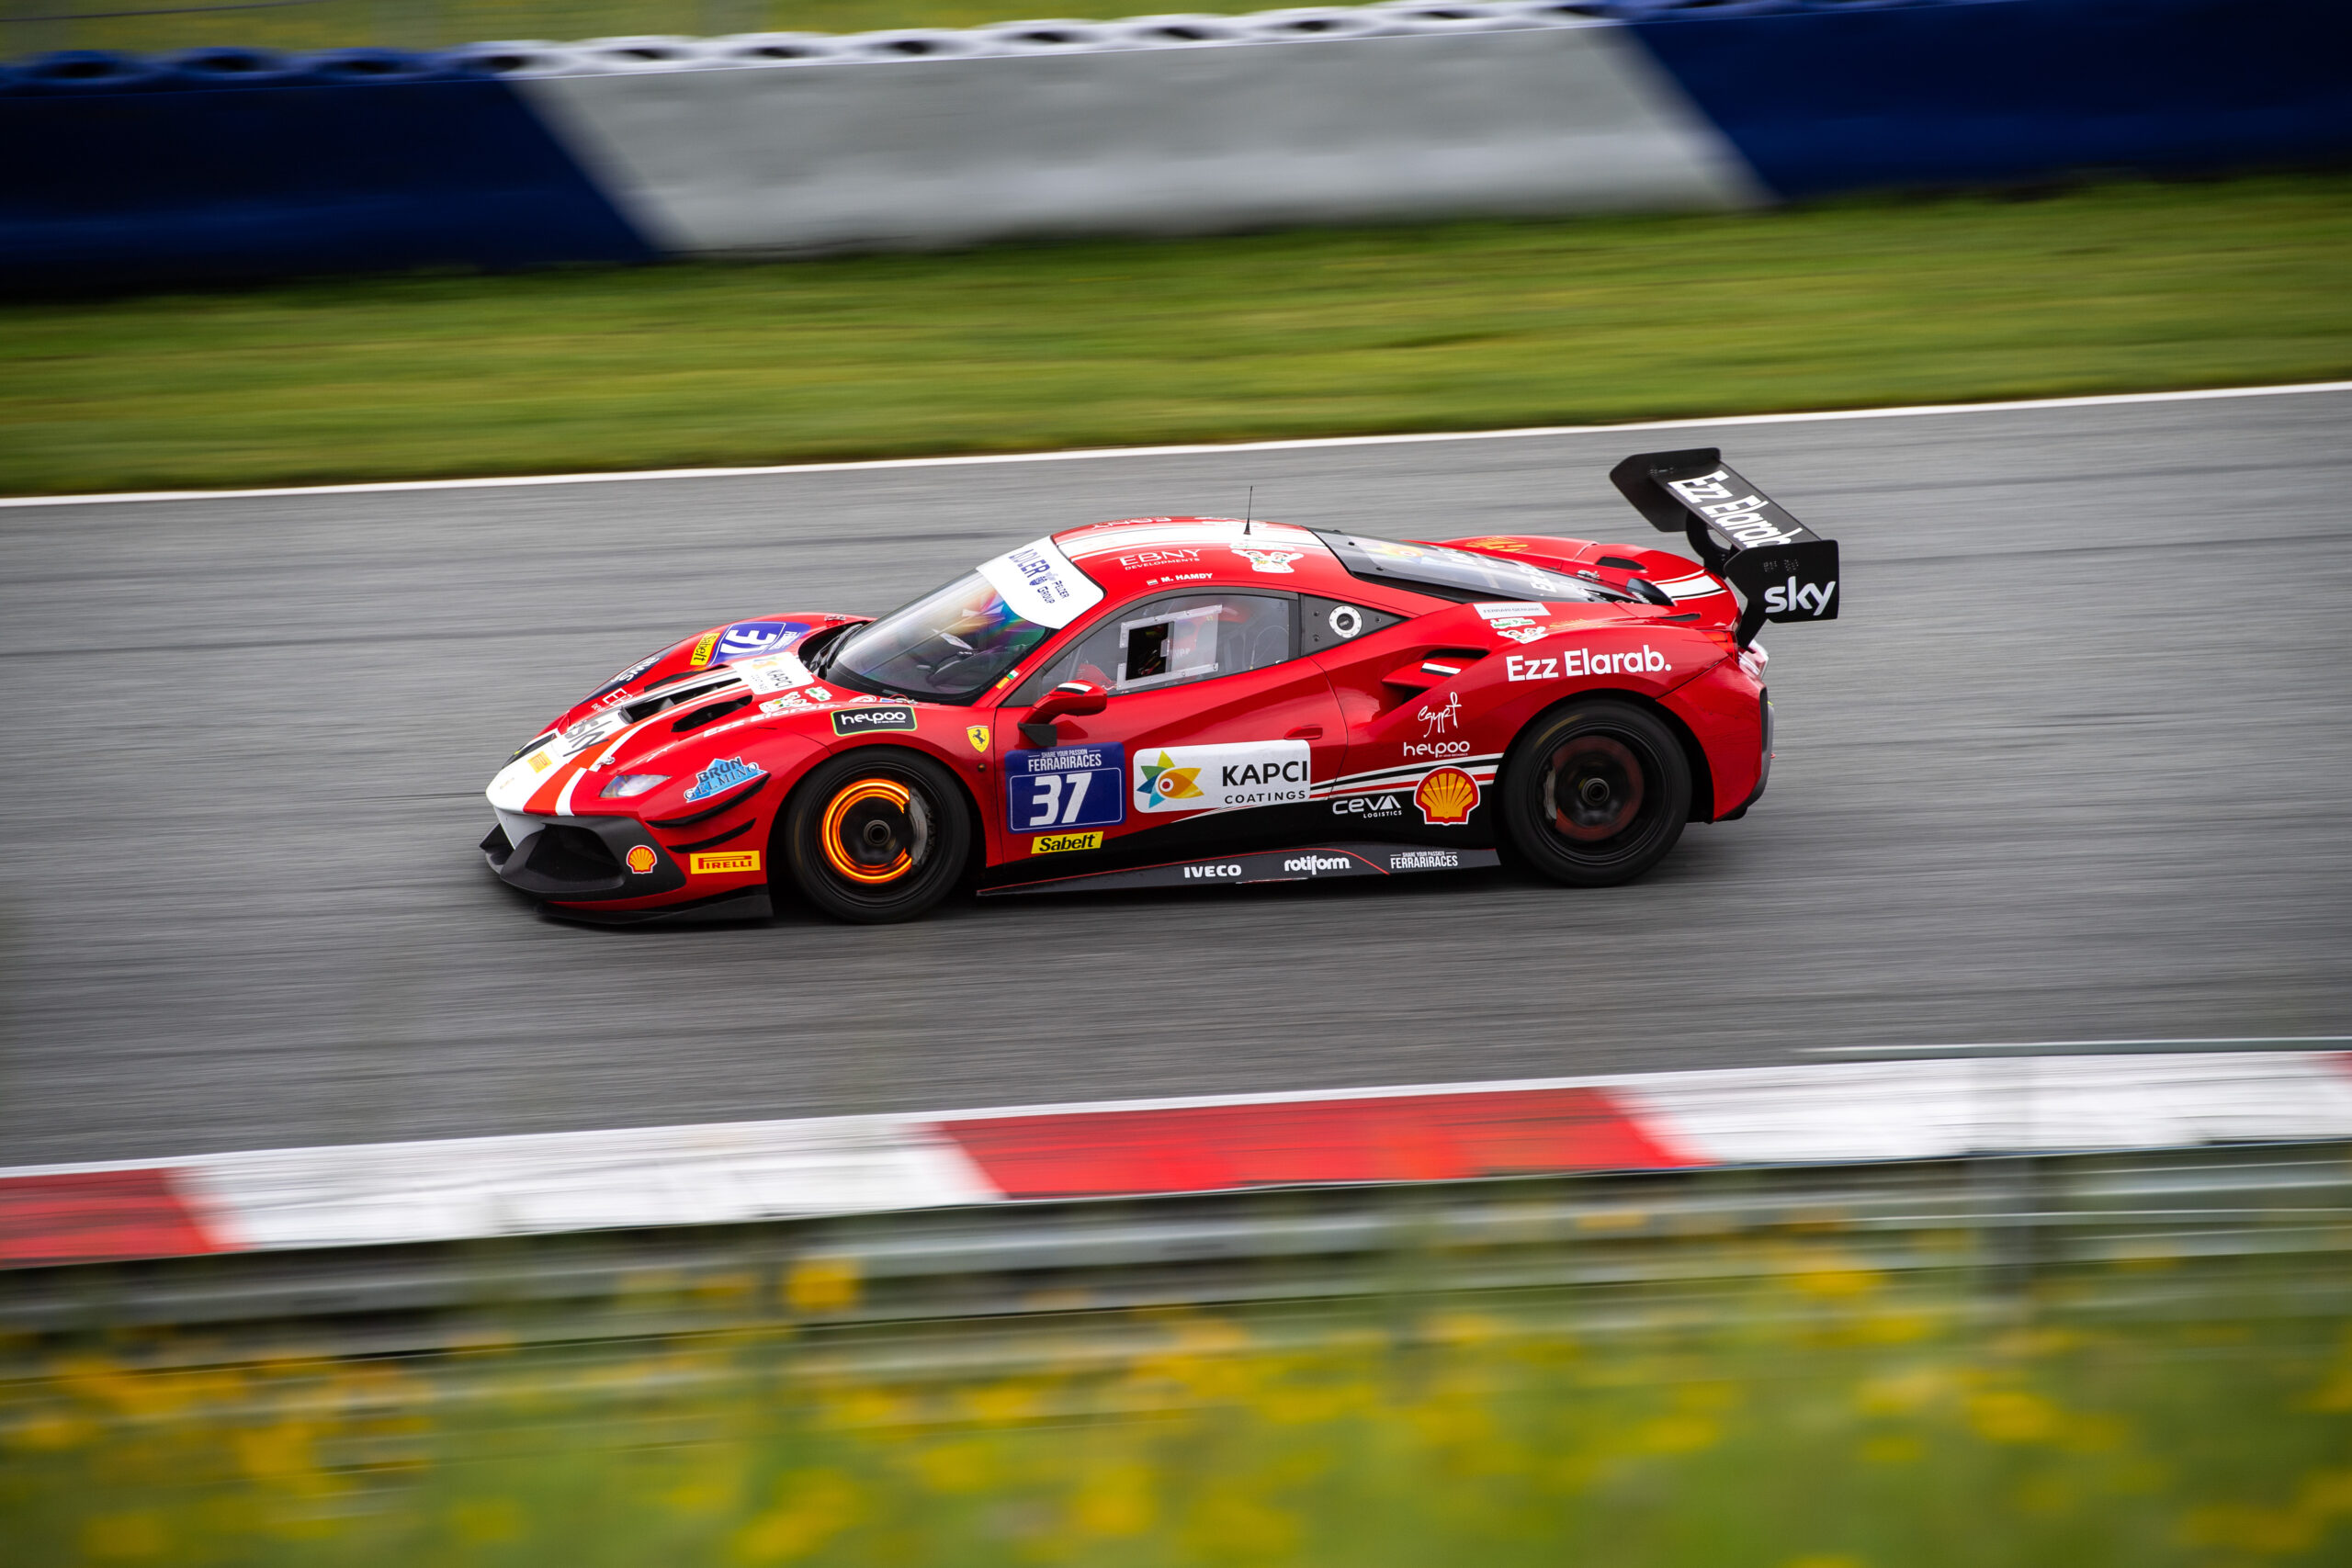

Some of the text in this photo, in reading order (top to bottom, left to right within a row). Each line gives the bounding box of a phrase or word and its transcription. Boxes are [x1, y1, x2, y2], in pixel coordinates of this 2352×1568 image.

[1668, 470, 1733, 503] Ezz
[1009, 548, 1051, 578] ADLER
[1120, 549, 1201, 567] EBNY
[1125, 558, 1201, 570] DEVELOPMENTS
[1764, 576, 1837, 615] sky
[693, 635, 717, 662] Sabelt
[1506, 645, 1672, 682] Ezz Elarab.
[841, 712, 907, 725] helpoo
[1403, 741, 1470, 759] helpoo
[697, 757, 743, 783] BRUN
[1028, 754, 1102, 773] FERRARIRACES
[684, 762, 759, 801] GELMINO
[1222, 761, 1307, 786] KAPCI
[1029, 772, 1092, 827] 37
[1225, 790, 1306, 804] COATINGS
[1363, 810, 1402, 818] LOGISTICS
[1039, 834, 1096, 852] Sabelt
[698, 855, 752, 870] PIRELLI
[1183, 864, 1242, 878] IVECO
[1283, 854, 1350, 875] rotiform
[1390, 855, 1458, 869] FERRARIRACES
